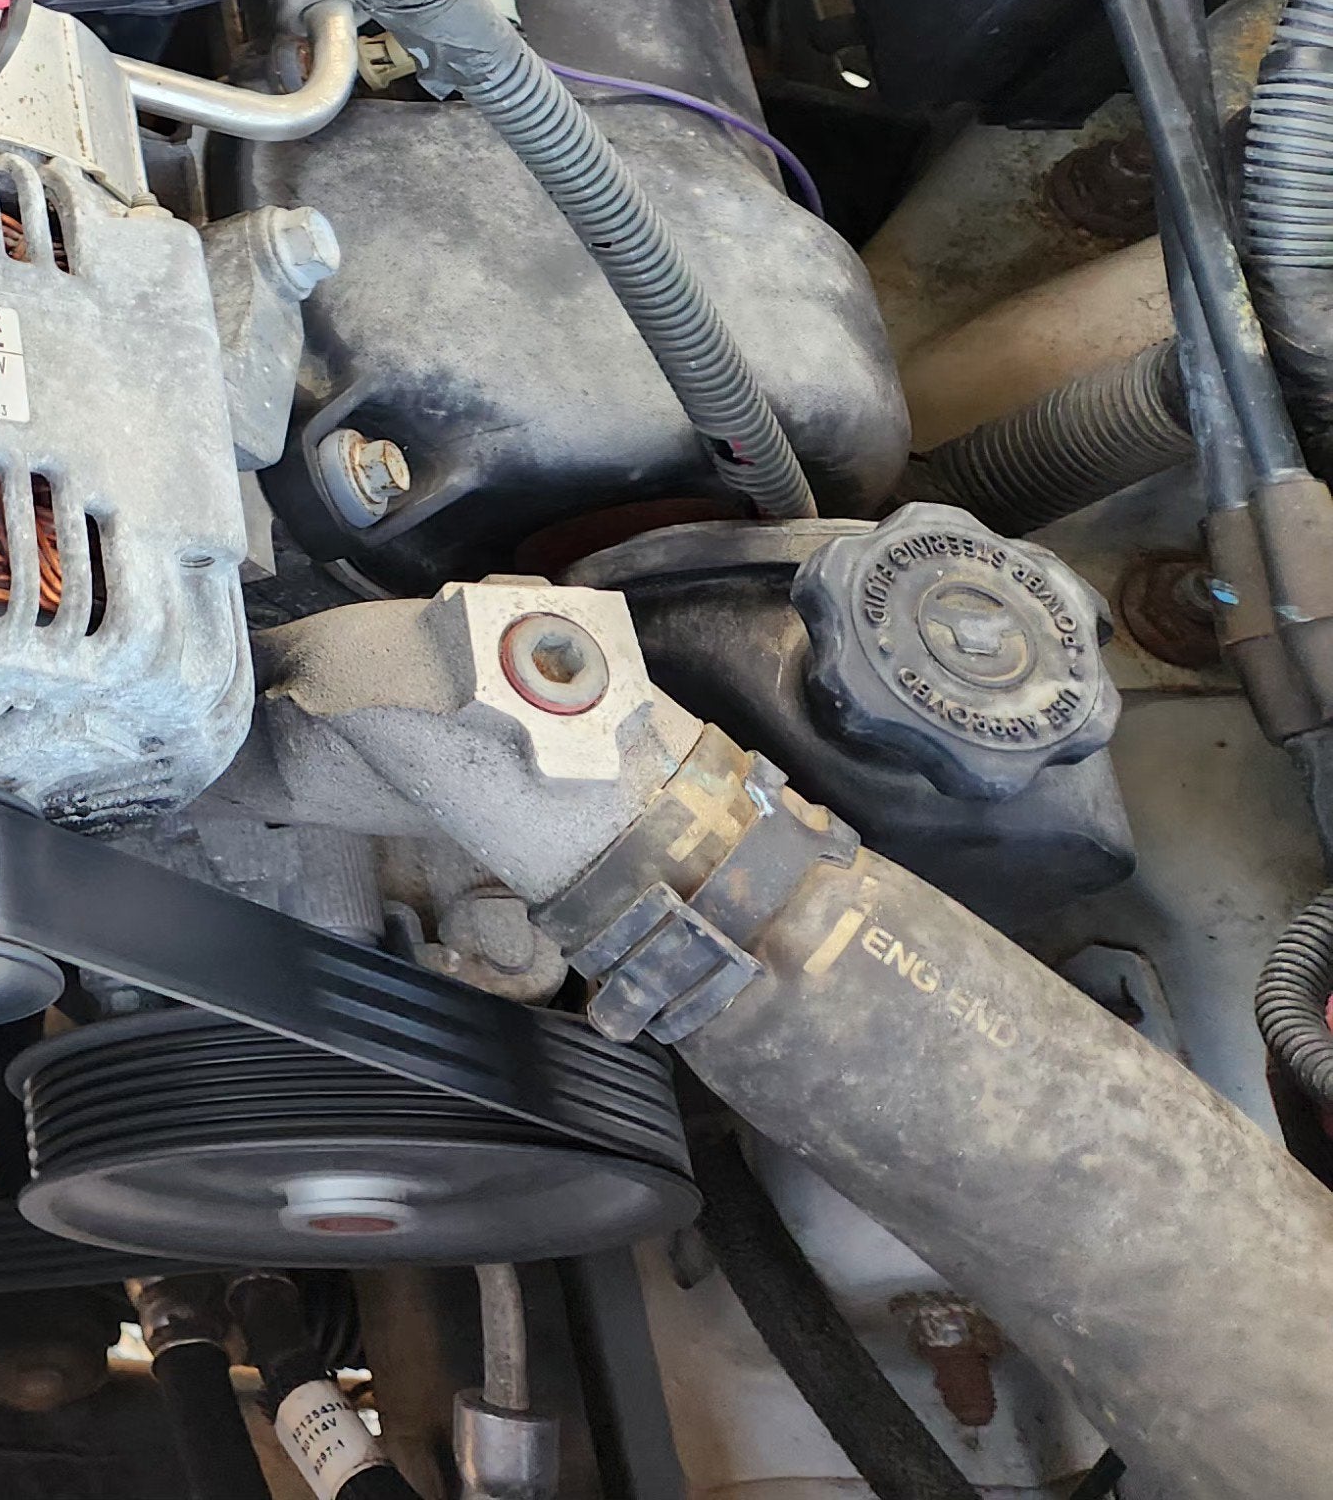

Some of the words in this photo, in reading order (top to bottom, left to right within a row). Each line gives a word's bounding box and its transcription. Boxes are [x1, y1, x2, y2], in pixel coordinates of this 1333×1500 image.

[888, 534, 1008, 571] STEERING
[864, 563, 895, 629] FLUID
[1010, 562, 1085, 655] POWER
[897, 666, 1041, 742] APPROVED
[1039, 687, 1081, 731] USE
[861, 925, 941, 993] ENG
[947, 986, 1018, 1048] END
